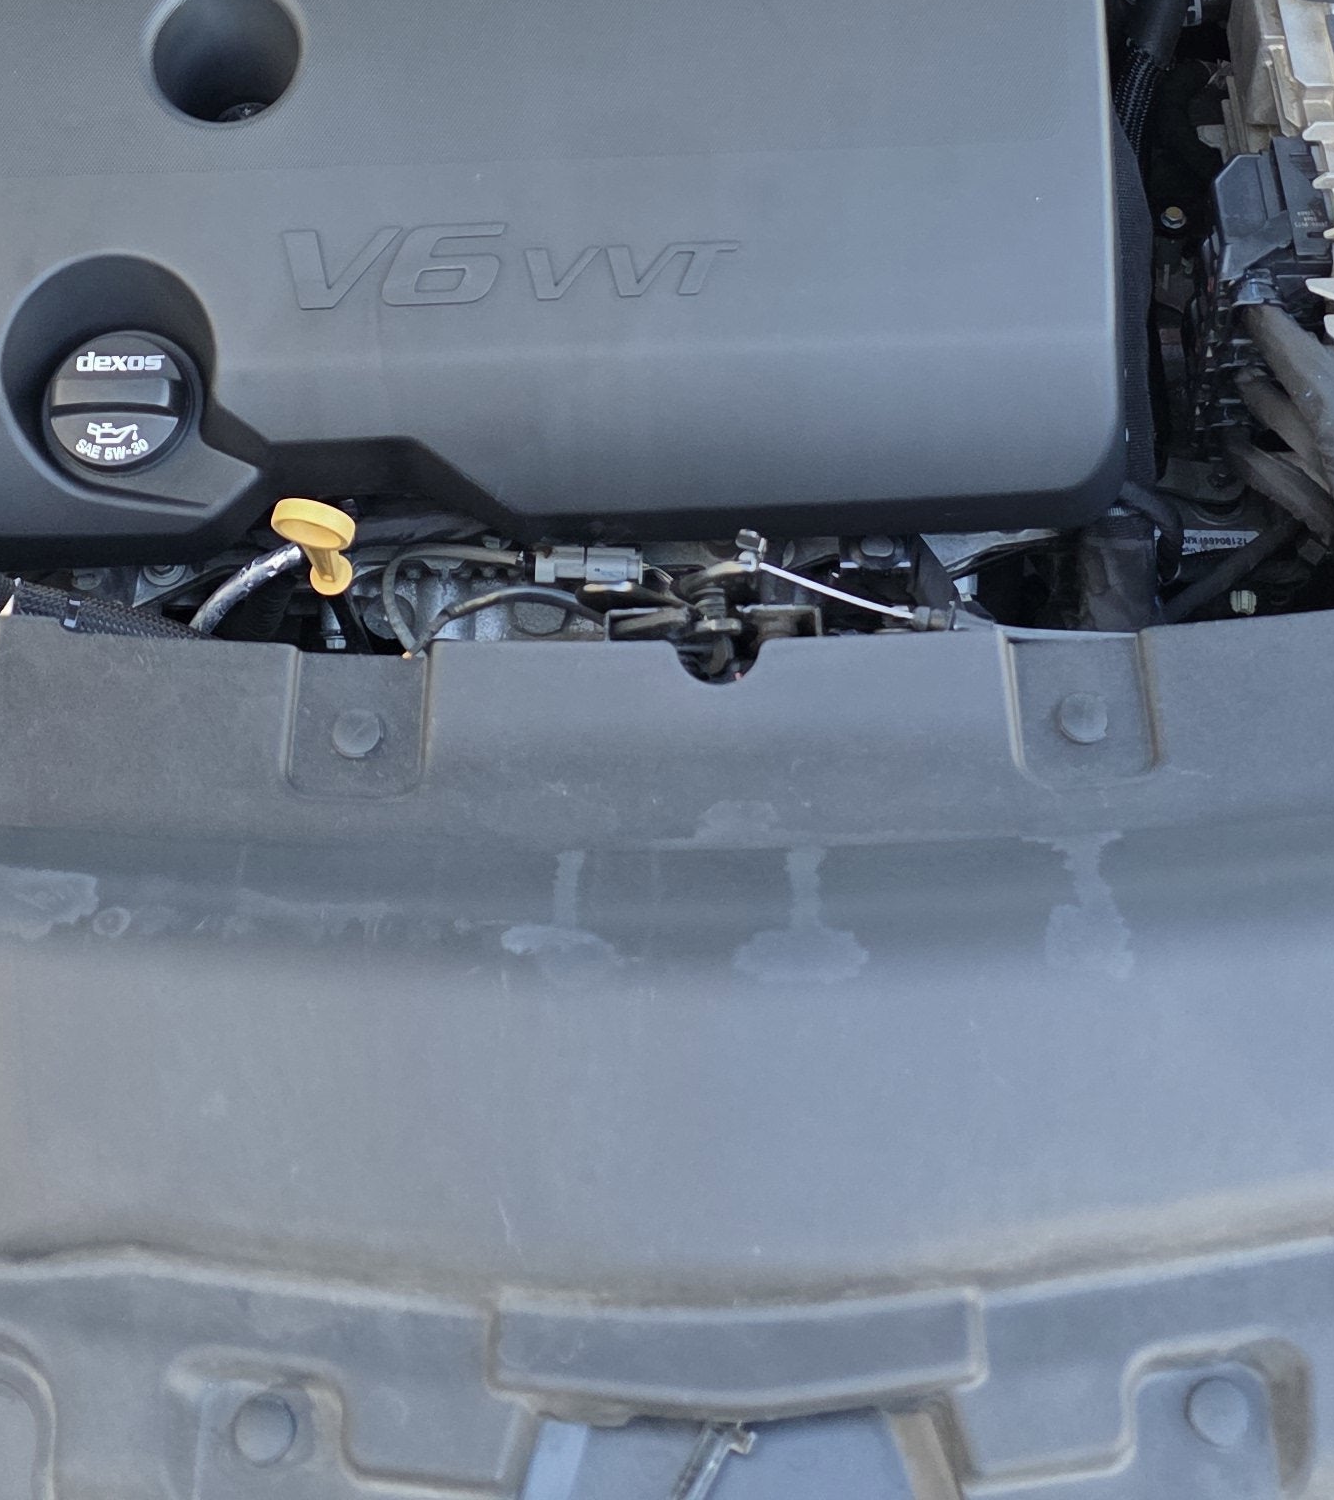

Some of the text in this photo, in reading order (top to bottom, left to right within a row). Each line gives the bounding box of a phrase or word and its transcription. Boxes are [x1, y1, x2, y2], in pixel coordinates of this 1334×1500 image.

[283, 222, 739, 310] V6 VVT
[76, 352, 166, 372] dexos
[75, 439, 149, 460] SAE 5W-30
